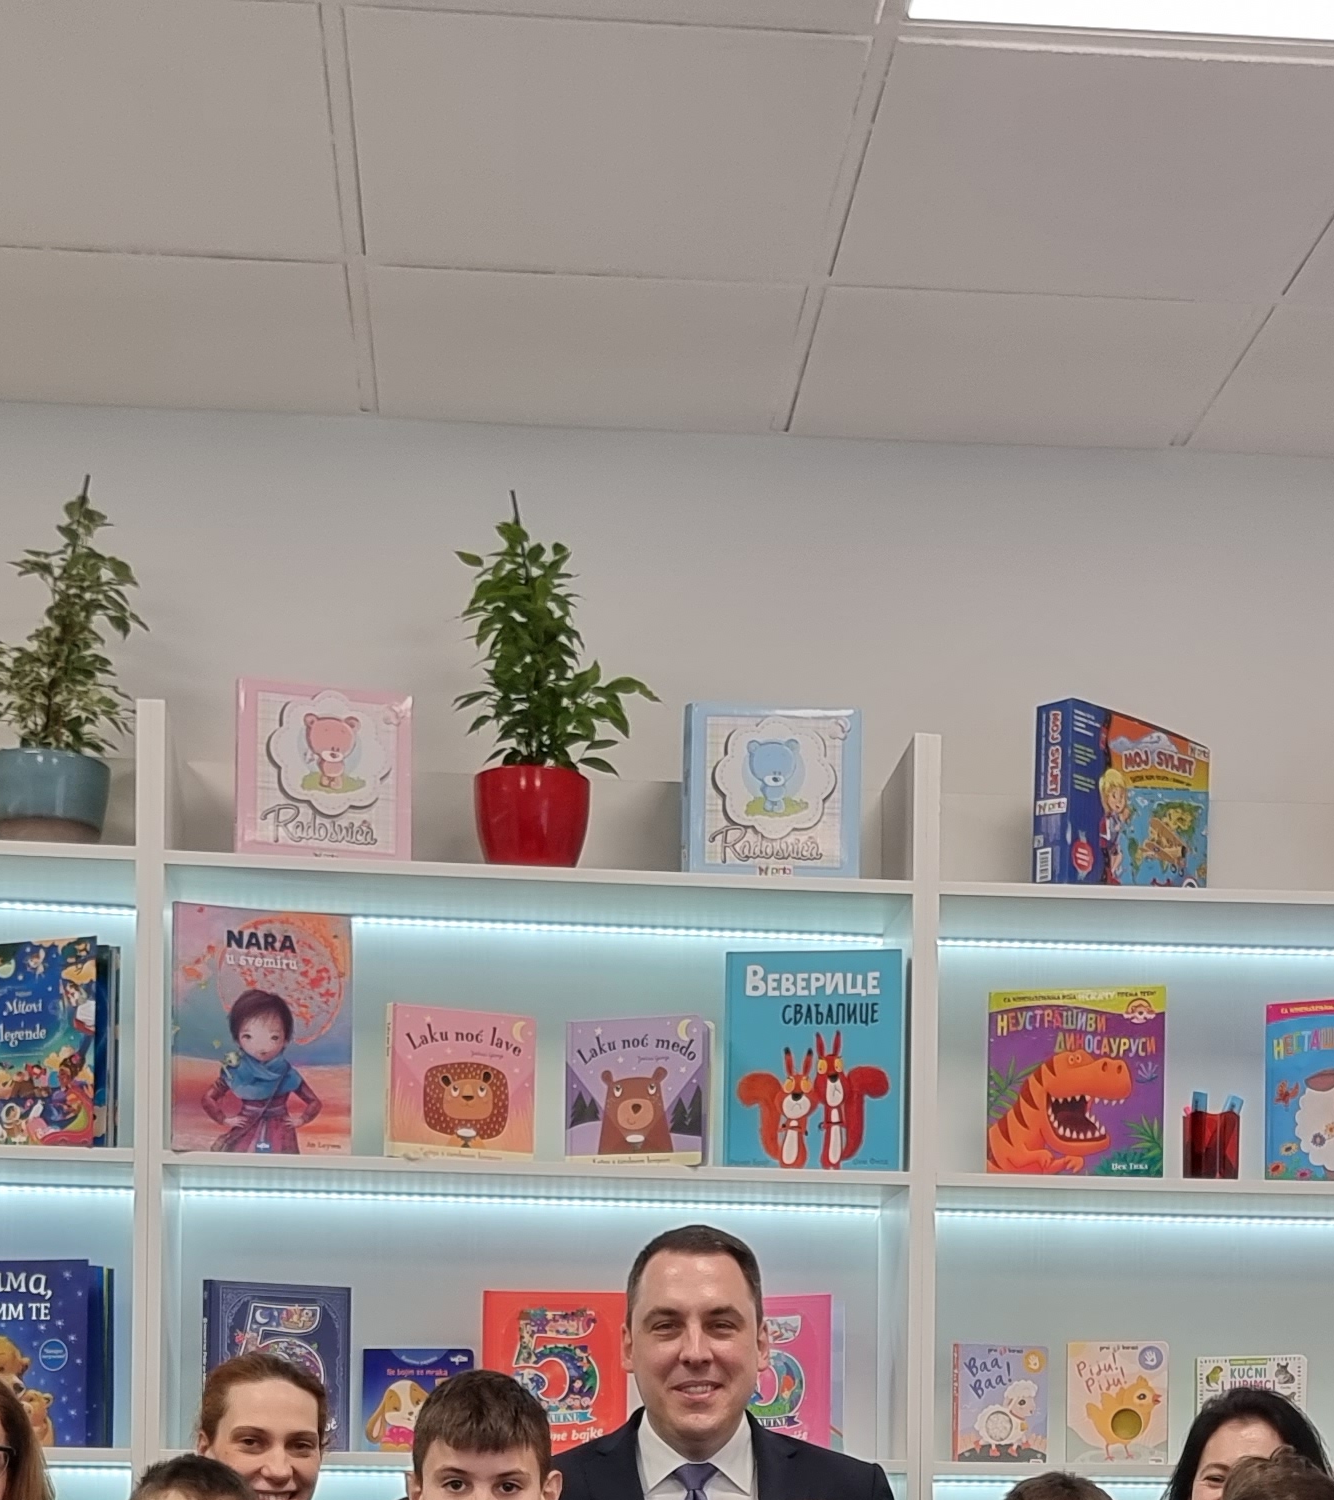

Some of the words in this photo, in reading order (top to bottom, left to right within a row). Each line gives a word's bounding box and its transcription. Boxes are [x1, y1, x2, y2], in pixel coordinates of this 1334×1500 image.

[1122, 749, 1152, 772] MOJ
[226, 929, 297, 954] NARA
[226, 954, 235, 965] u
[239, 955, 298, 970] svemiru
[745, 964, 881, 997] ВЕВЕРИЦЕ
[996, 1009, 1108, 1036] НЕУСТРАШИВИ
[405, 1023, 449, 1050] Laku
[455, 1029, 484, 1044] noć
[490, 1026, 523, 1057] lave
[576, 1035, 617, 1066] Laku
[622, 1033, 649, 1049] noć
[654, 1038, 697, 1062] medo
[1054, 1031, 1156, 1058] ДИНОСАУРУСИ
[28, 1302, 51, 1321] ТЕ
[511, 1307, 601, 1412] 5
[964, 1356, 1003, 1378] Baa
[1229, 1365, 1267, 1379] KUĆNI
[969, 1361, 1013, 1399] Baa!
[571, 1428, 604, 1445] bajke
